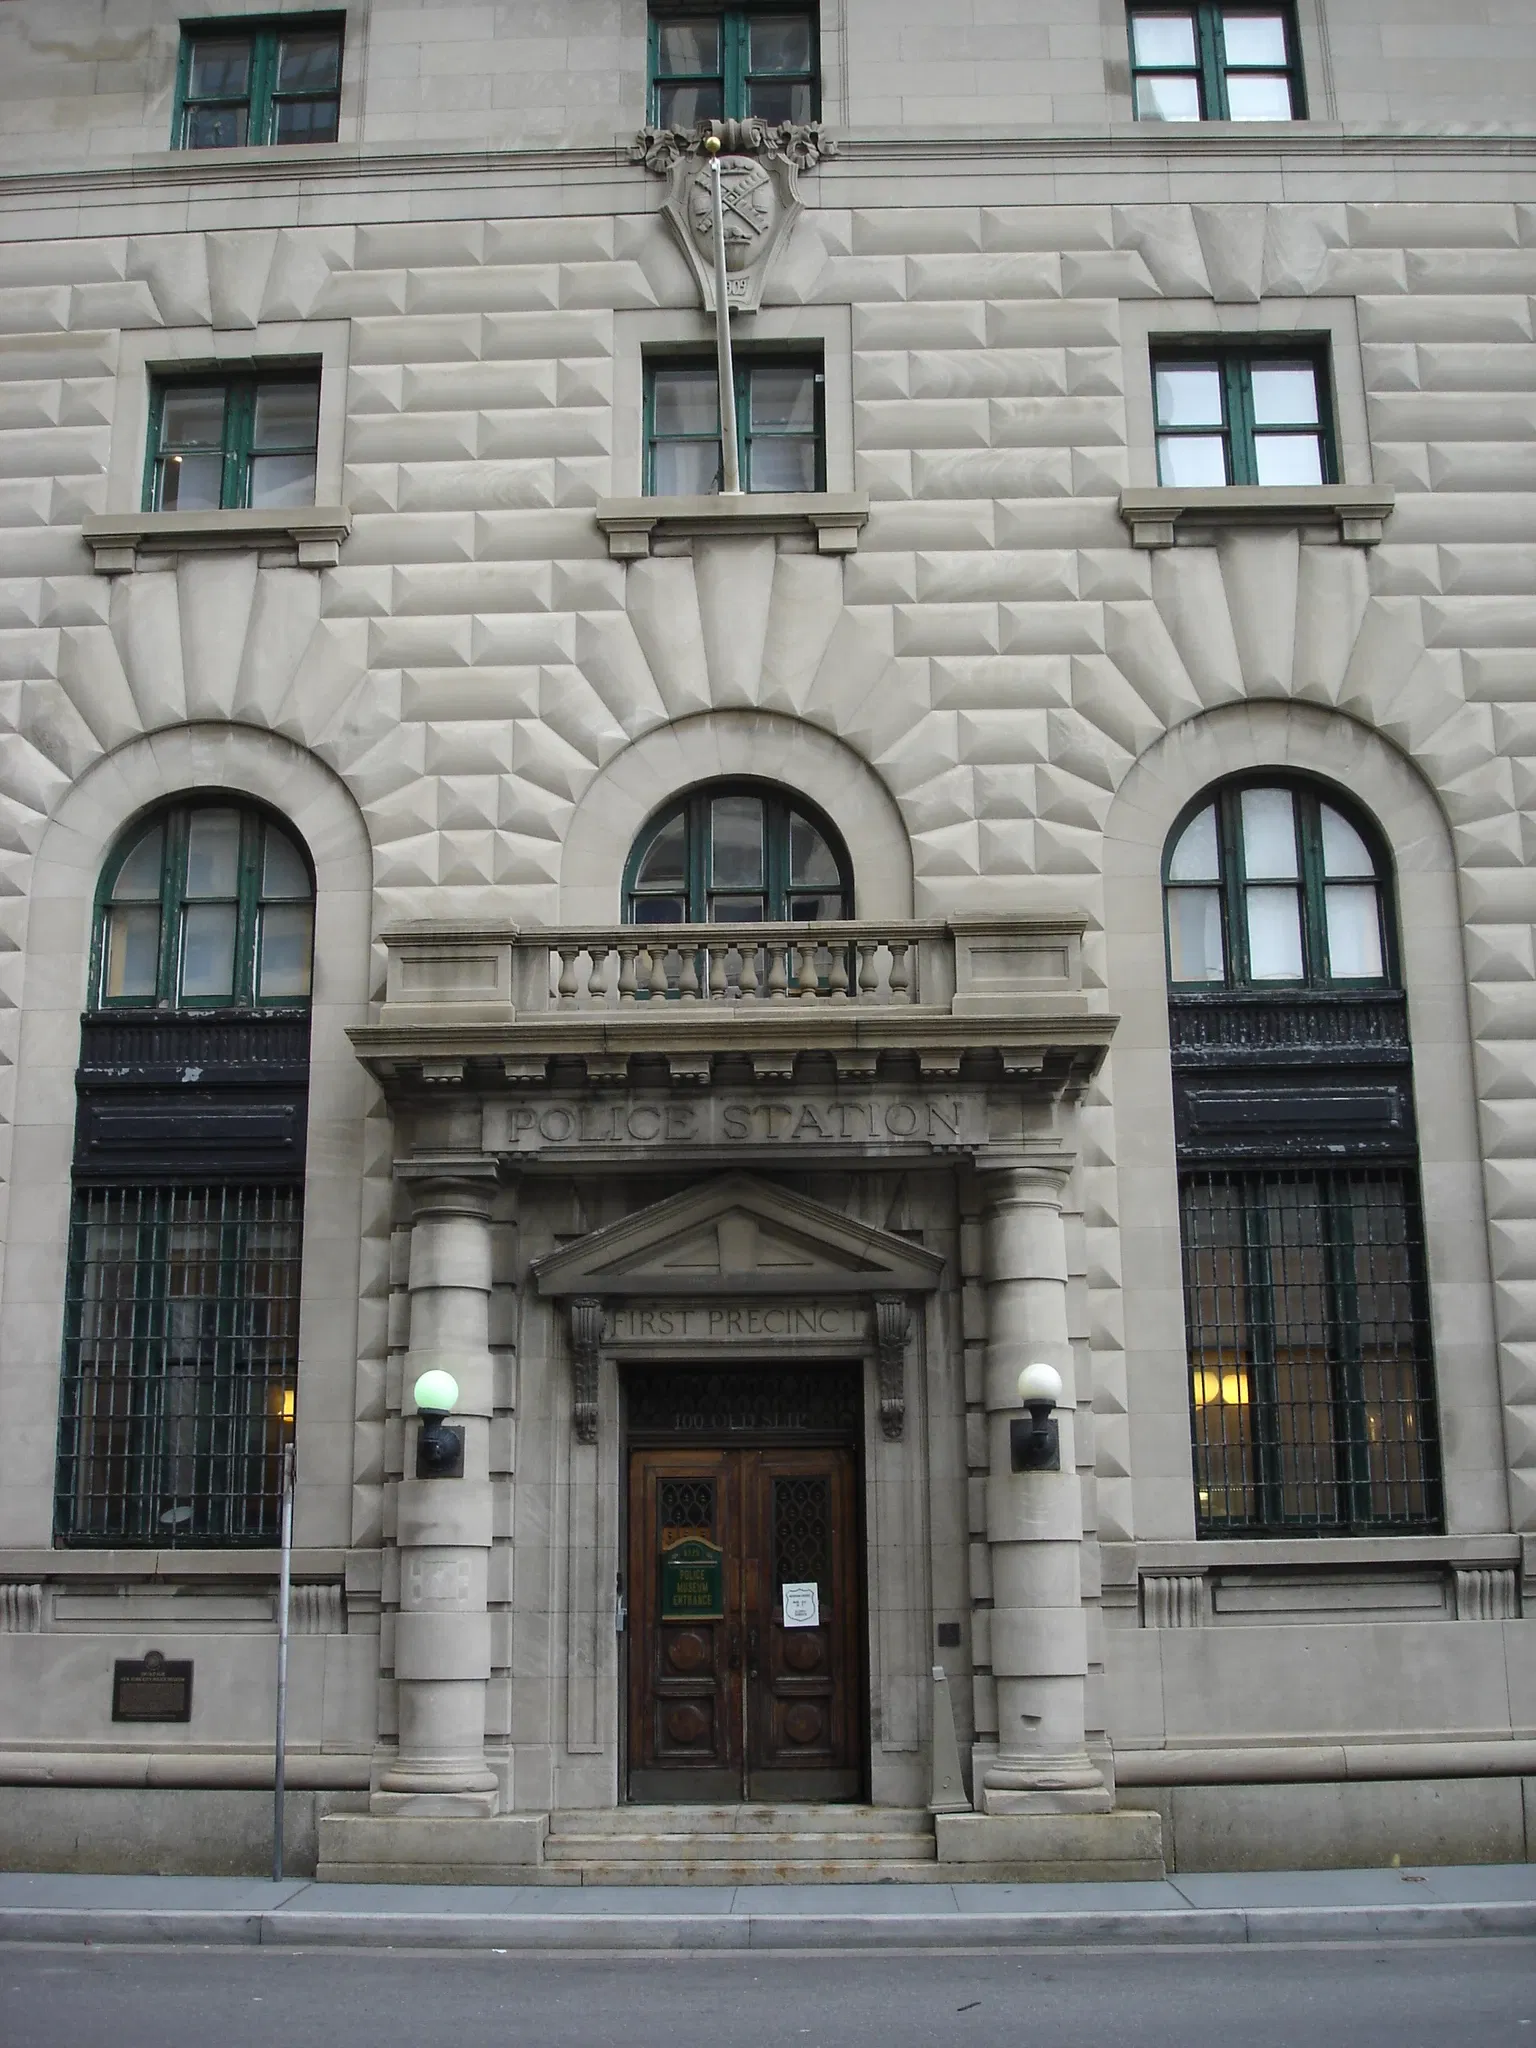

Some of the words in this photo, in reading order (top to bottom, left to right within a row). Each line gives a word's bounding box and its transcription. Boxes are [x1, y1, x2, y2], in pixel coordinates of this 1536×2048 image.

[506, 1105, 699, 1143] POLICE
[722, 1100, 962, 1140] STATION
[610, 1309, 696, 1337] FIRST
[708, 1307, 861, 1335] PRECINCT
[674, 1412, 704, 1430] 100
[679, 1569, 705, 1580] POLICE
[672, 1594, 713, 1606] ENTRANCE
